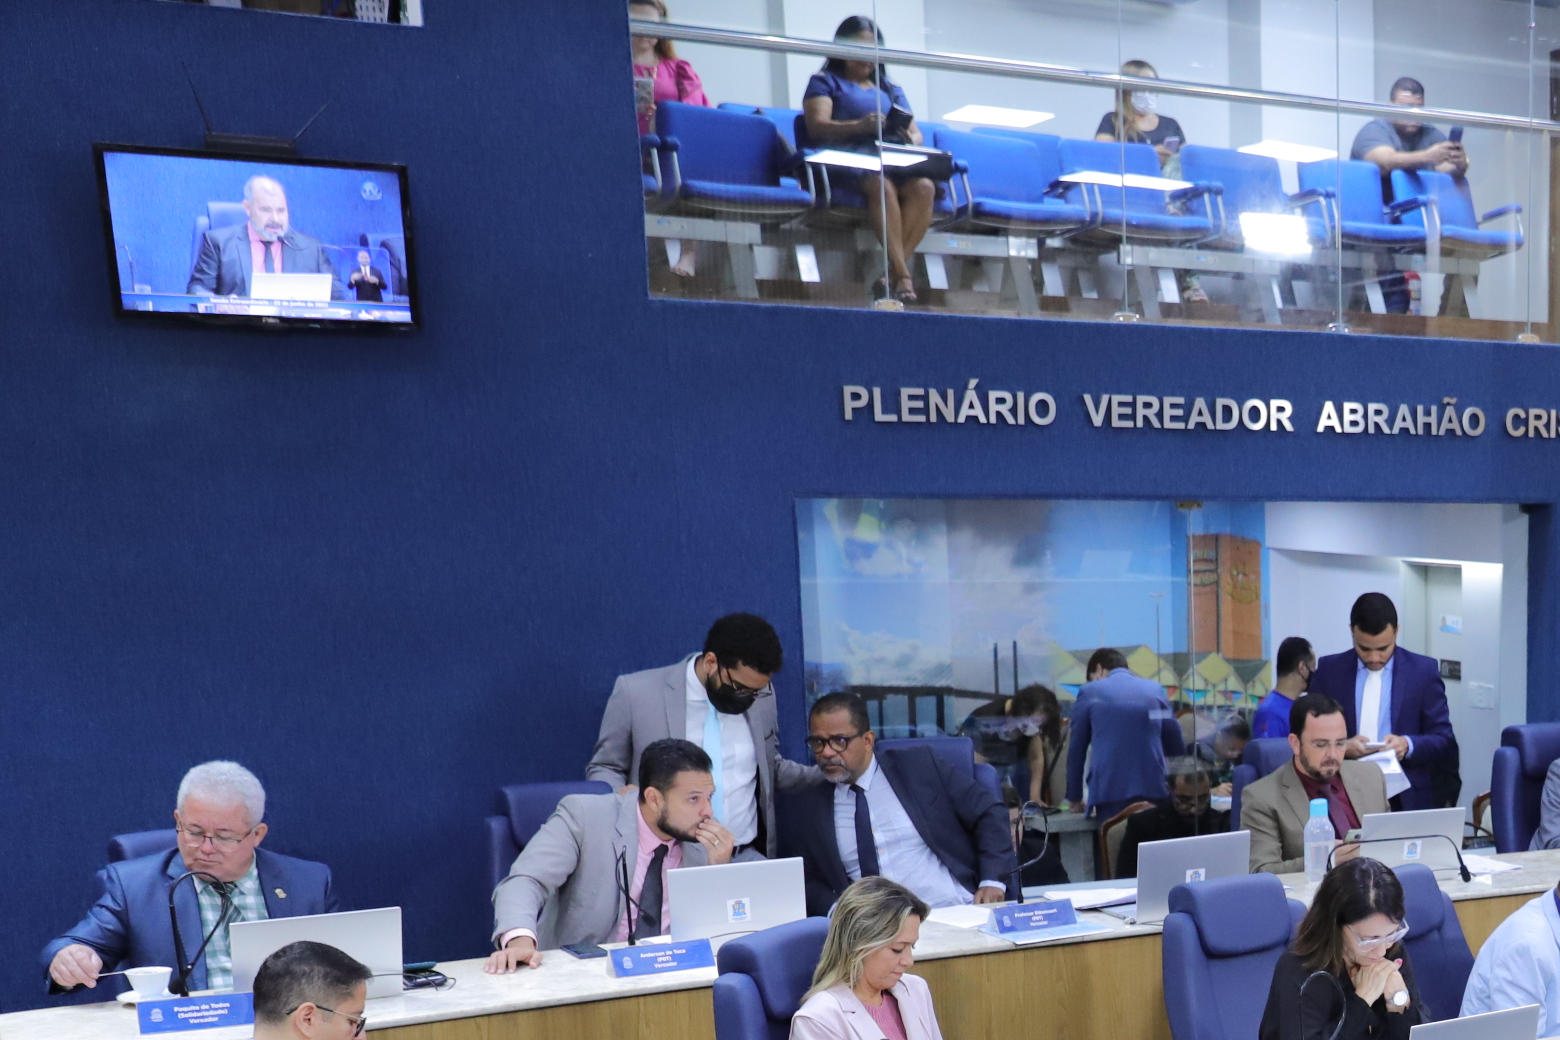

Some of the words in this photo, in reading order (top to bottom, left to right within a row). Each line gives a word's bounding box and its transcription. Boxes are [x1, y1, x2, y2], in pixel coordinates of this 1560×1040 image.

[842, 379, 1057, 426] PLENÁRIO
[1083, 393, 1294, 432] VEREADOR
[1316, 397, 1486, 437] ABRAHÃO
[653, 961, 678, 969] Vereador
[174, 1005, 200, 1013] Paquito
[177, 1009, 228, 1019] (Solidariedade)
[188, 1016, 219, 1024] Vereador
